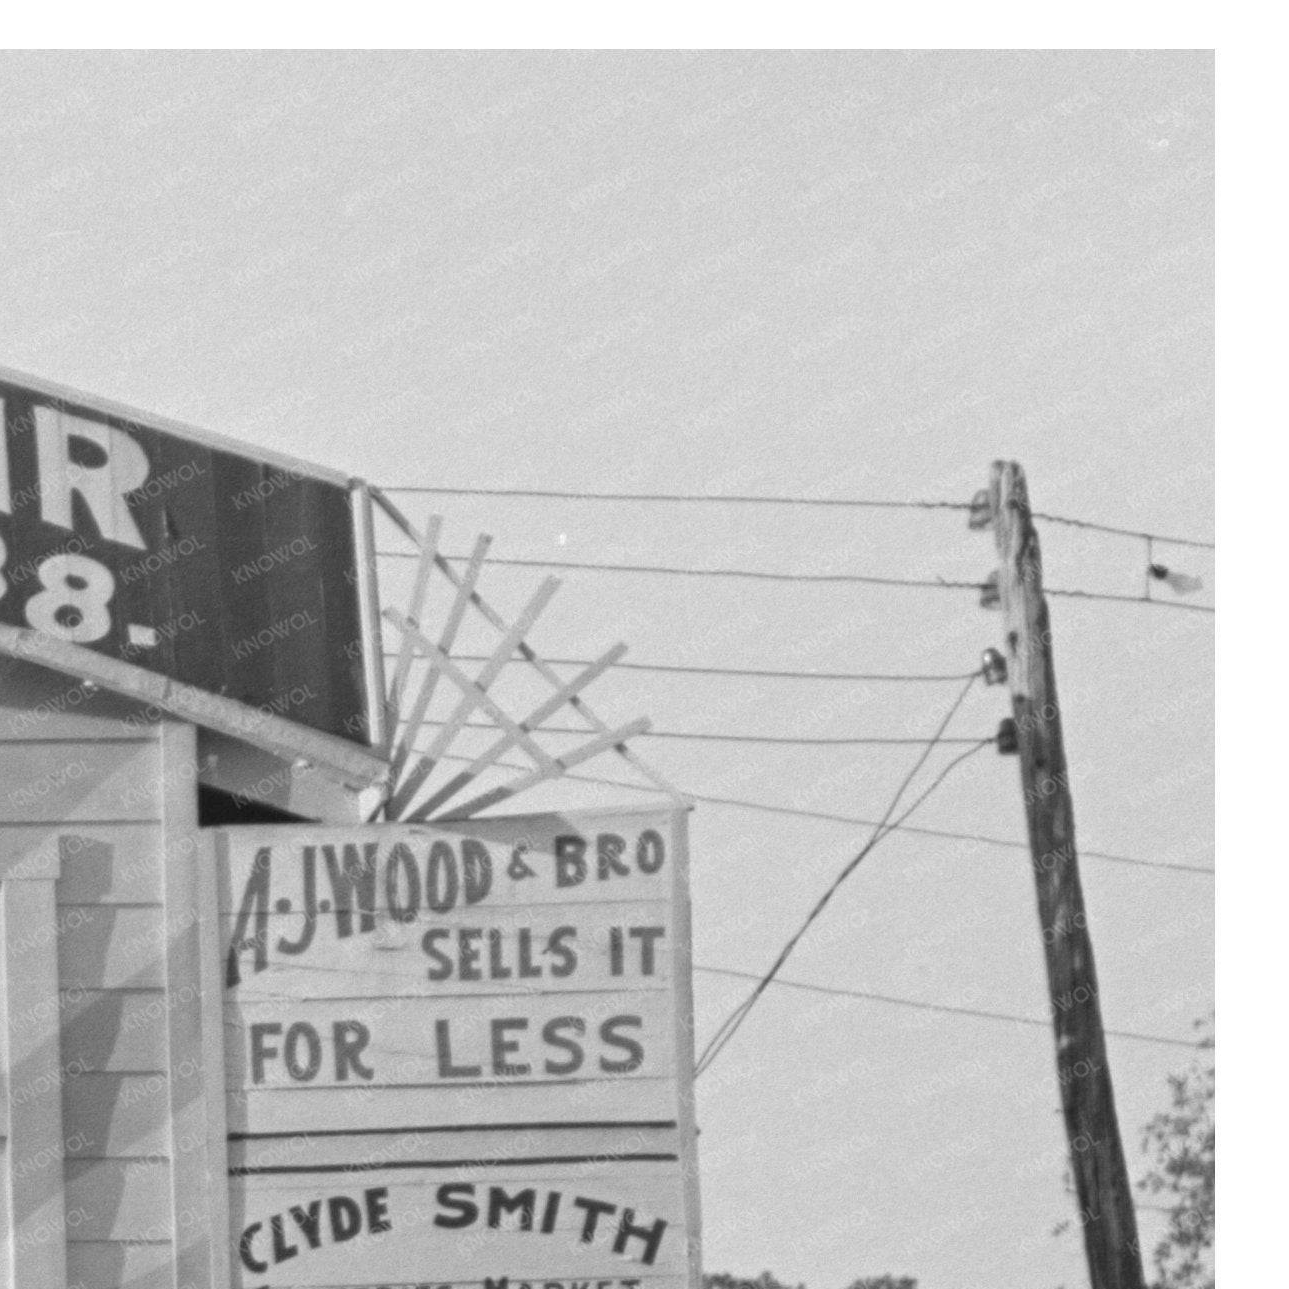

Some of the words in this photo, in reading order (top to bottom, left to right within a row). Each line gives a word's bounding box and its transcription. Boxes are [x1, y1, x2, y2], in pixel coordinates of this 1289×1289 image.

[507, 846, 537, 881] &
[555, 829, 665, 888] BRO
[421, 926, 579, 982] SELLS
[610, 926, 665, 976] IT
[250, 1020, 374, 1084] FOR
[435, 1015, 645, 1078] LESS
[239, 1186, 392, 1274] CLYDE
[433, 1182, 668, 1265] SMITH
